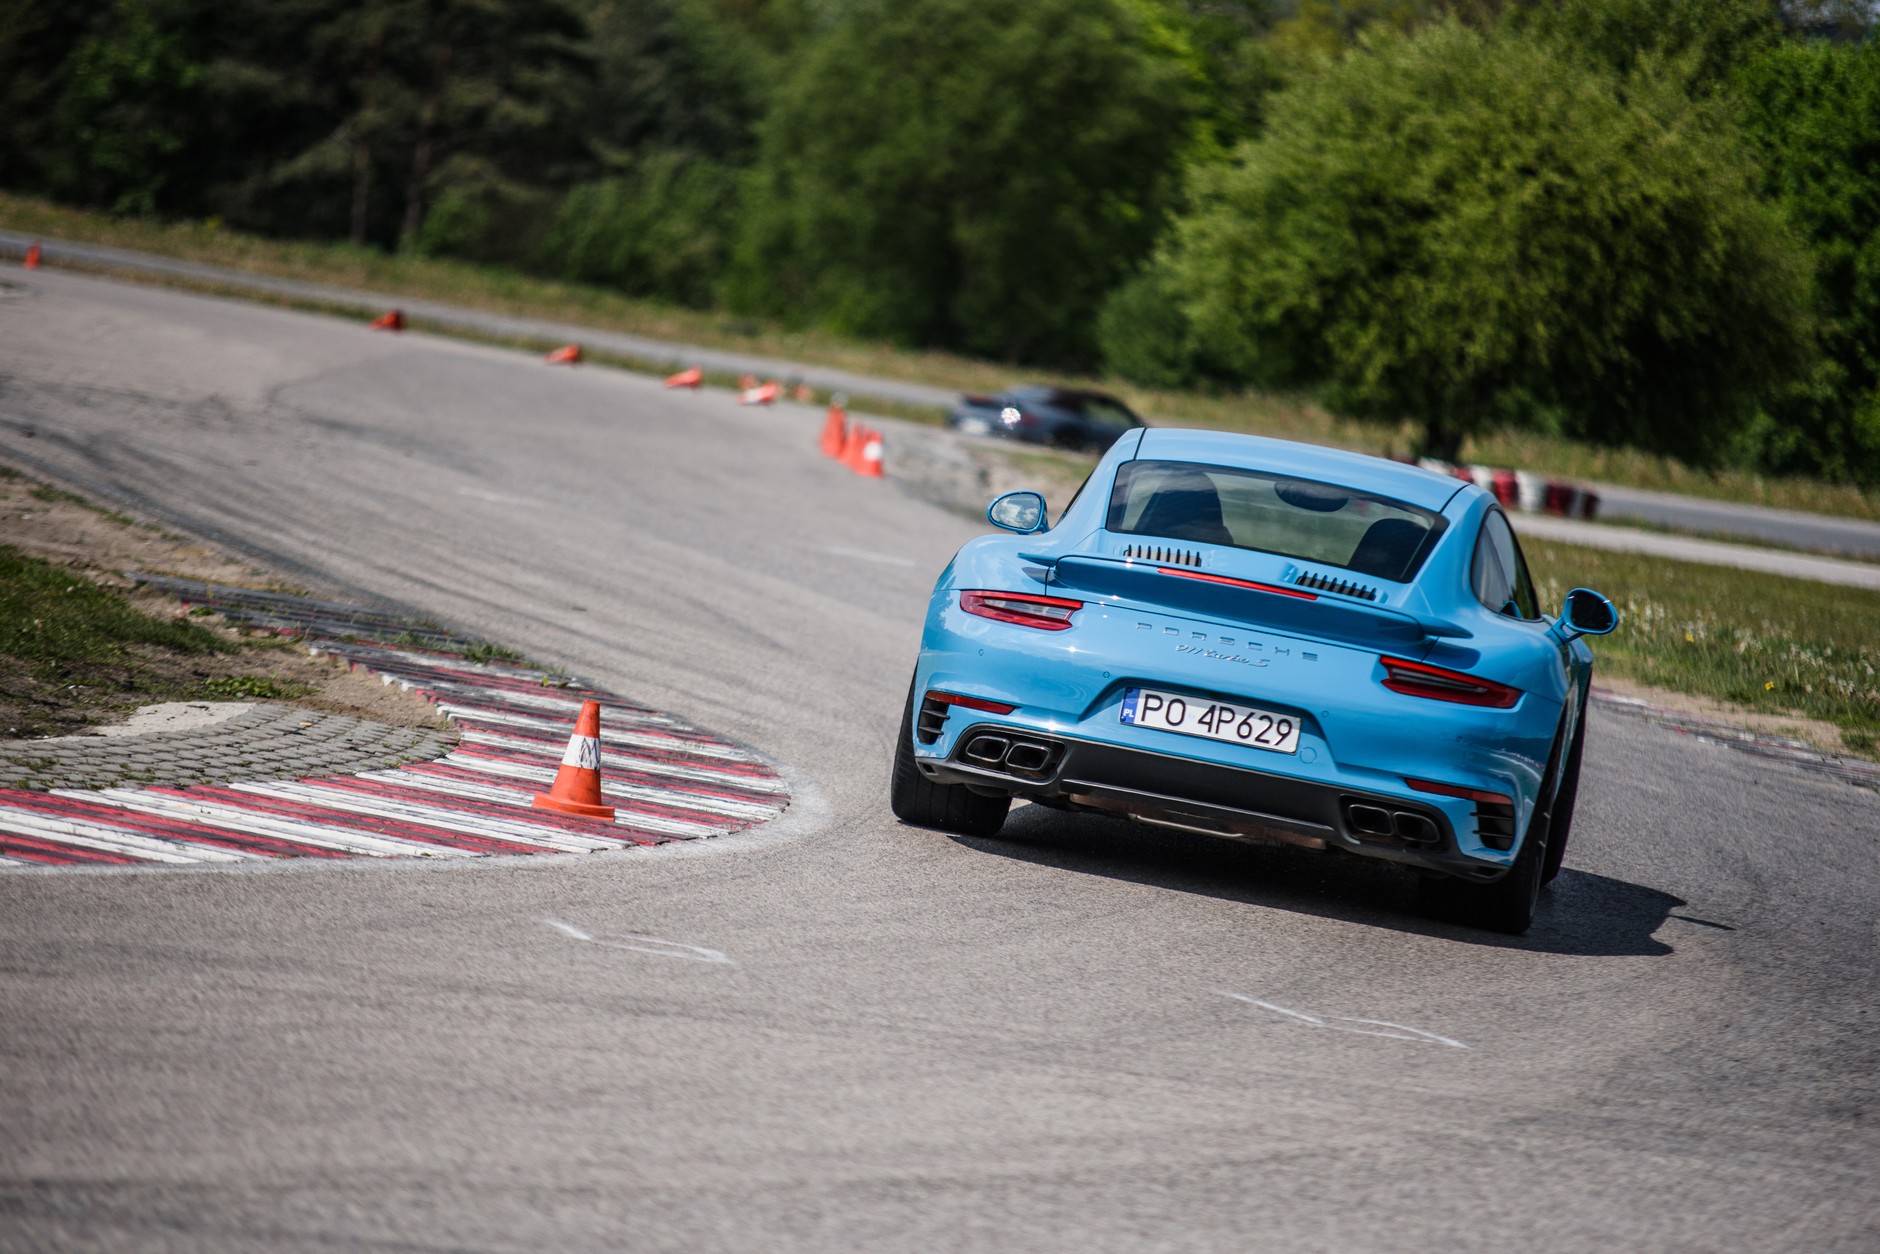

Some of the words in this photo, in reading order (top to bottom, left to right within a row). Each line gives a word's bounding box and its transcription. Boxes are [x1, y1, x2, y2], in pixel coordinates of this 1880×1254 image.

[1136, 622, 1319, 662] PORSCHE
[1174, 643, 1203, 655] 911
[1203, 649, 1250, 665] turbo
[1248, 658, 1271, 668] S
[1123, 708, 1134, 718] PL
[1140, 693, 1187, 727] PO
[1197, 704, 1293, 746] 4P629
